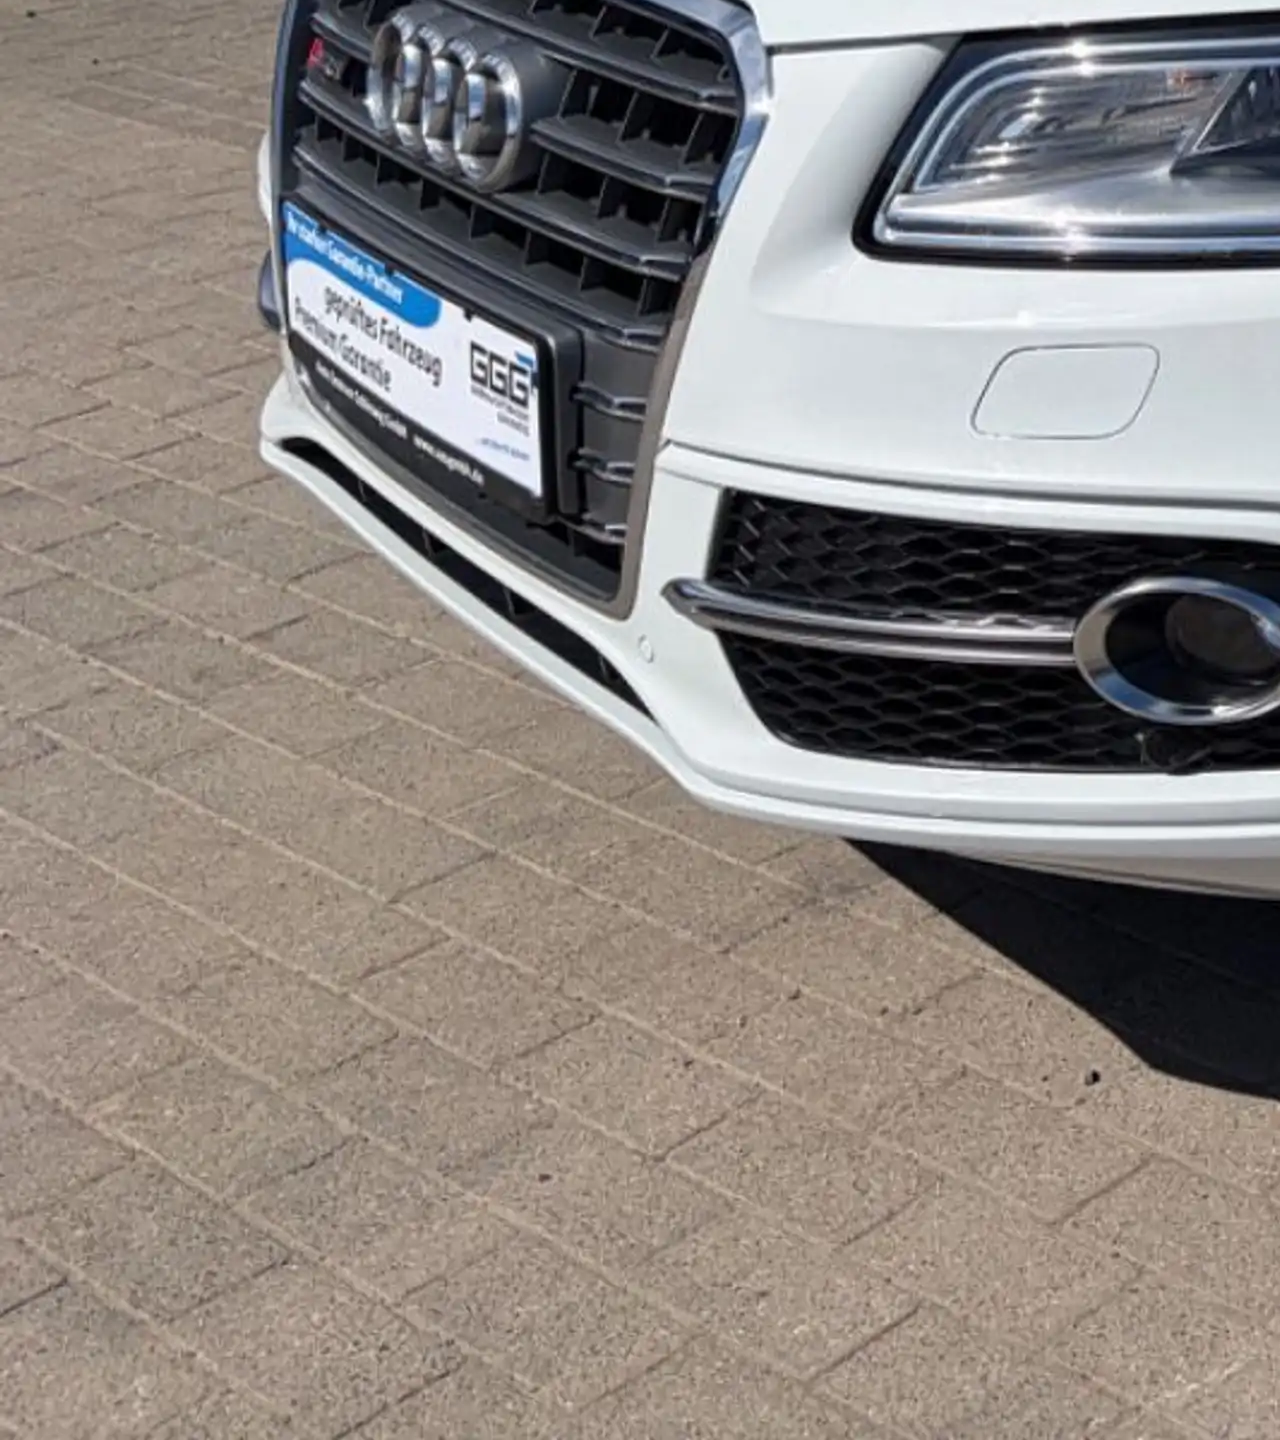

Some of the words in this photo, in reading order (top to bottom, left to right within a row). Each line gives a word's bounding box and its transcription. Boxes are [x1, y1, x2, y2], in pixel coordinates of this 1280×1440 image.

[324, 285, 379, 341] geprüftes
[379, 316, 442, 388] Fahrzeug
[338, 332, 392, 393] Garantie
[469, 340, 530, 410] GGG
